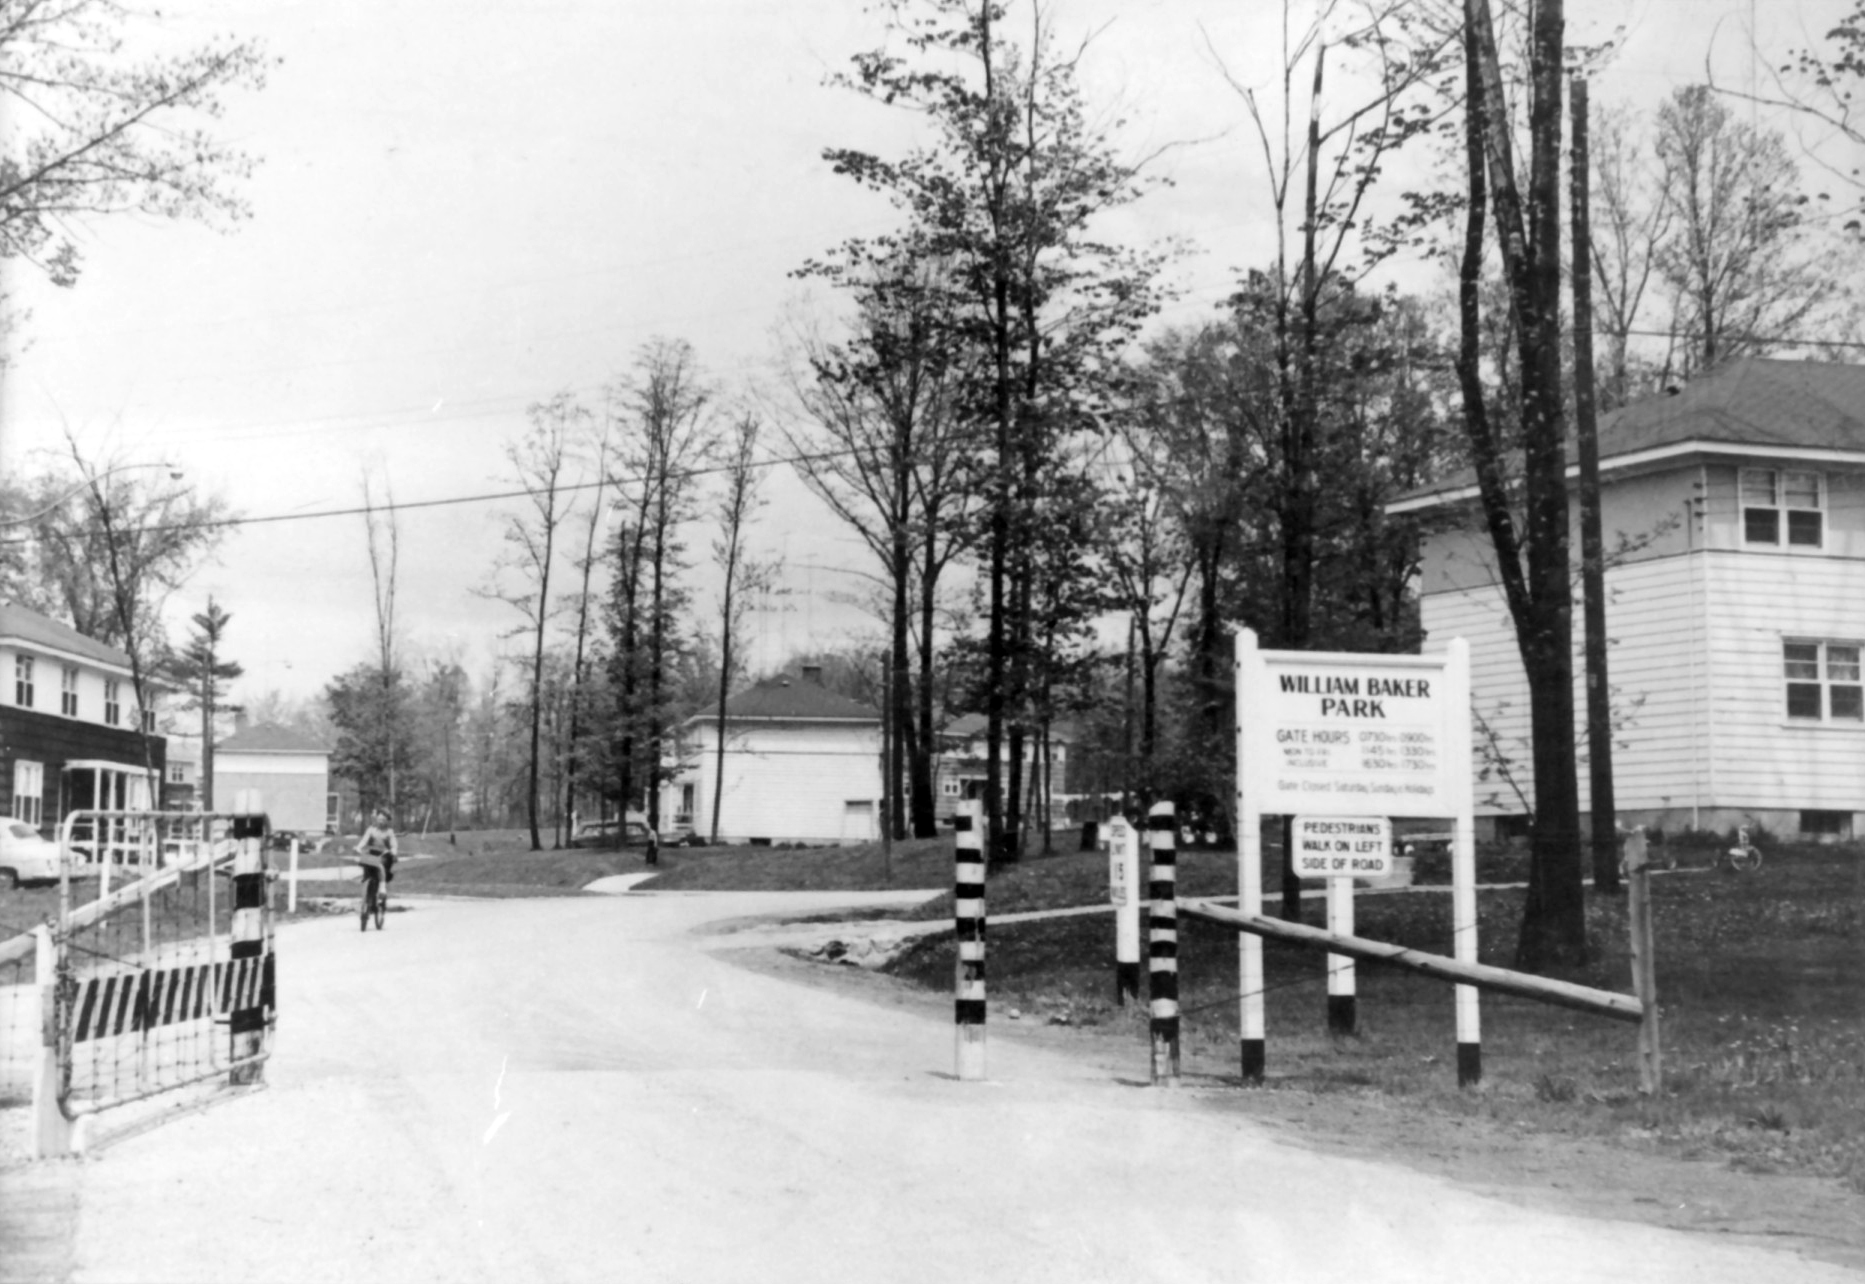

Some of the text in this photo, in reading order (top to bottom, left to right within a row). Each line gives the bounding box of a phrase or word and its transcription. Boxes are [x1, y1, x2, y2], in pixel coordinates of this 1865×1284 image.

[1279, 674, 1431, 698] WILLIAM BAKER
[1321, 698, 1386, 718] PARK
[1276, 729, 1308, 743] GATE
[1312, 730, 1350, 745] HOURS
[1277, 779, 1298, 790] Gate
[1302, 780, 1331, 792] Closed
[1303, 822, 1381, 835] PEDESTRIANS
[1302, 840, 1383, 853] WALK ON LEFT
[1302, 857, 1384, 871] SIDE OF ROAD
